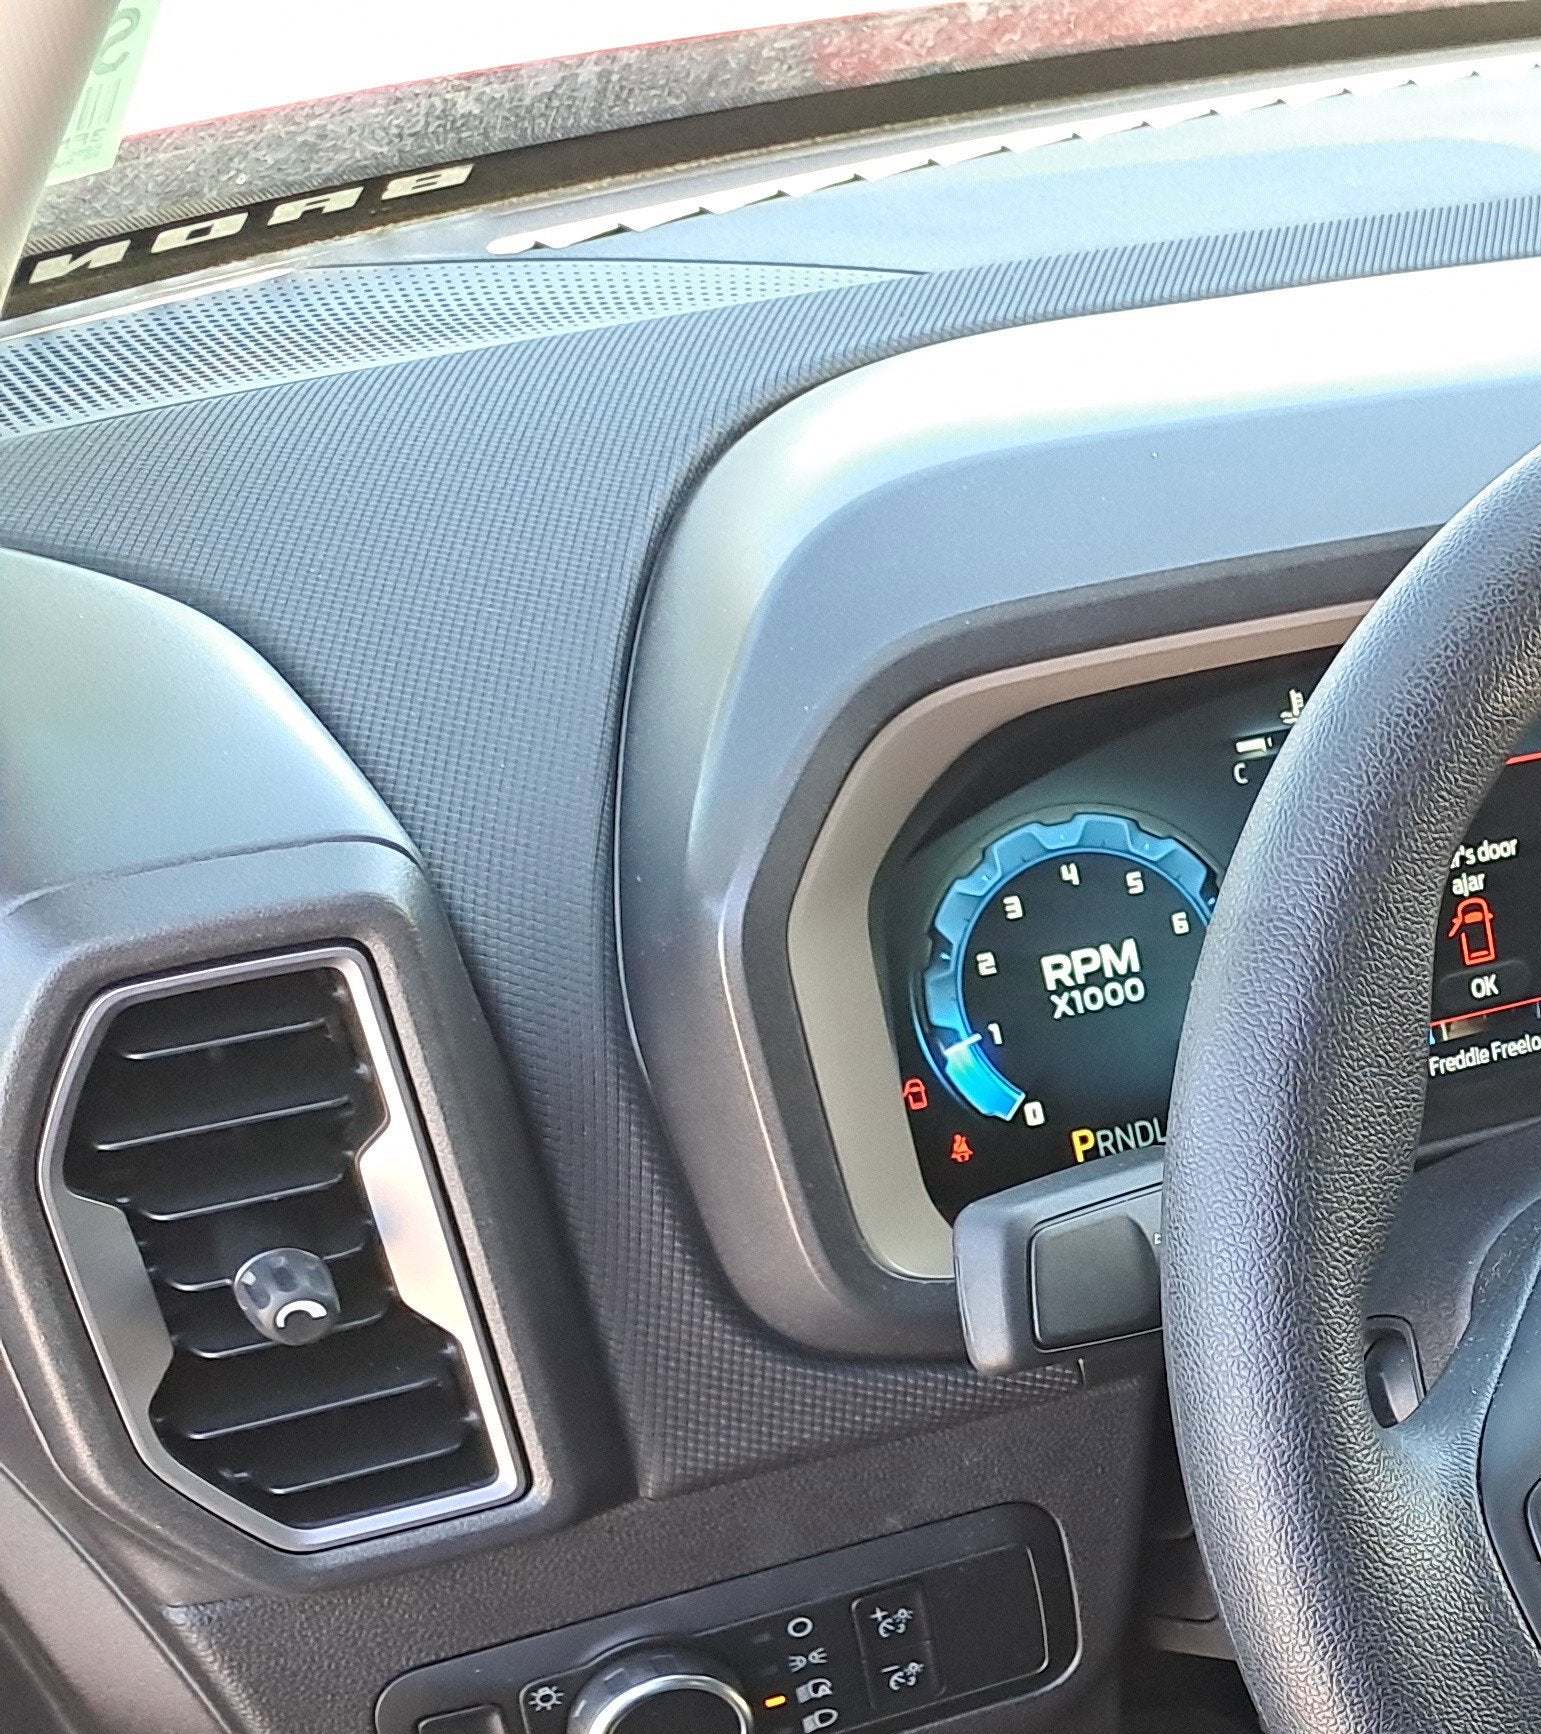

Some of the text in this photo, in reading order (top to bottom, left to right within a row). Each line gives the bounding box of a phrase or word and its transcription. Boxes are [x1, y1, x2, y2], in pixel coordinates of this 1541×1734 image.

[1477, 838, 1519, 863] door
[1059, 863, 1081, 887] 4
[1125, 871, 1145, 896] 5
[1452, 873, 1486, 897] ajar
[1002, 896, 1024, 920] 3
[1171, 911, 1190, 935] 6
[976, 953, 997, 976] 2
[1040, 938, 1141, 991] RPM
[1050, 977, 1146, 1019] X1000
[1470, 974, 1499, 999] OK
[988, 1023, 1003, 1045] 1
[1429, 1046, 1490, 1077] Freddie
[1023, 1101, 1045, 1126] 0
